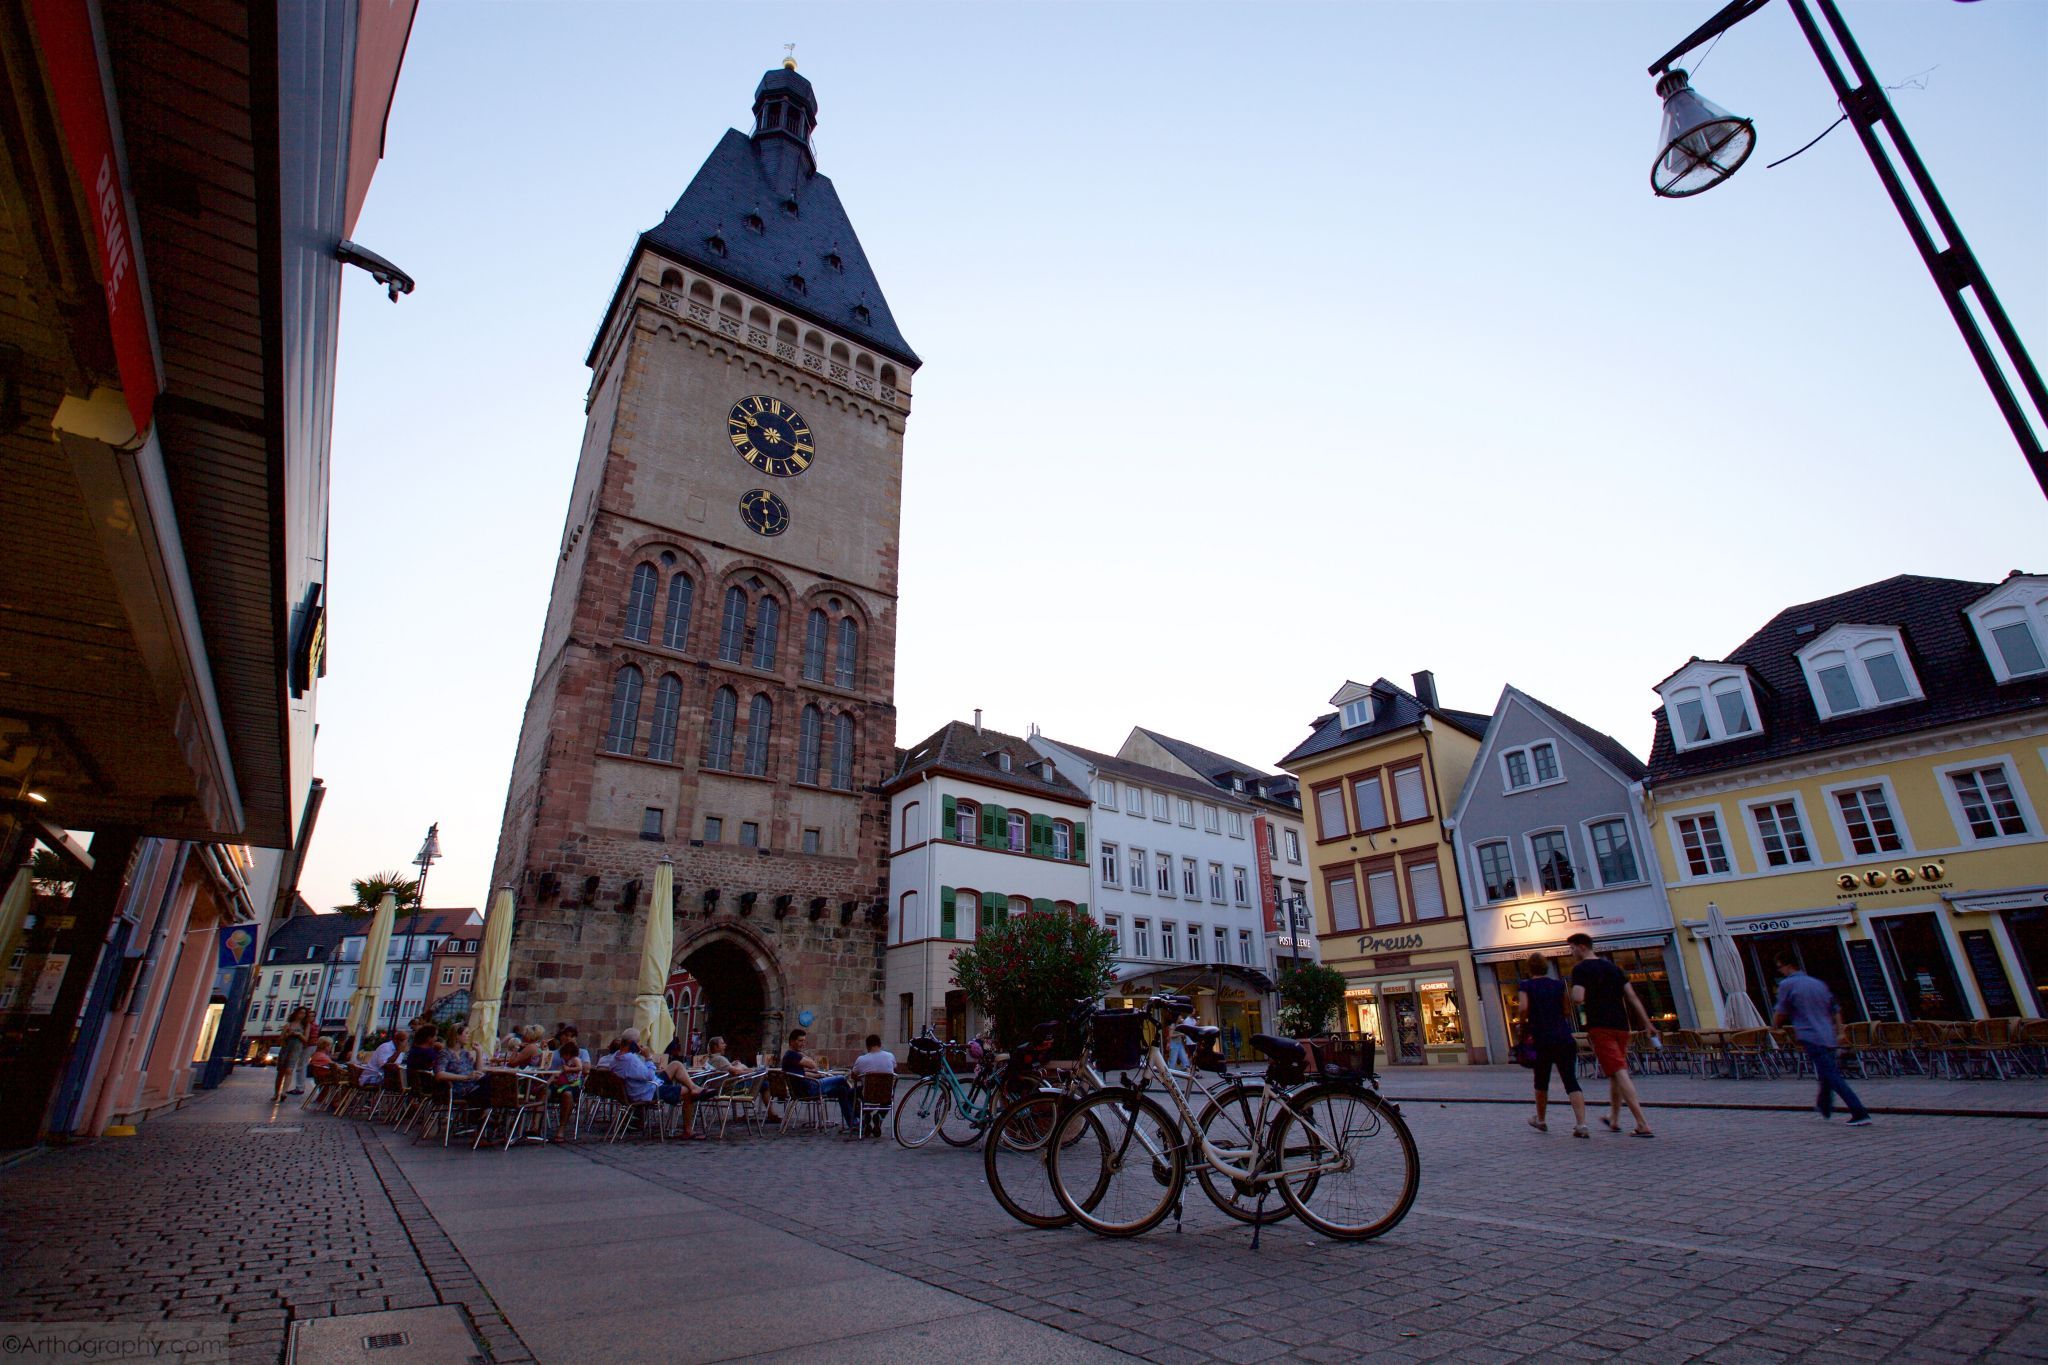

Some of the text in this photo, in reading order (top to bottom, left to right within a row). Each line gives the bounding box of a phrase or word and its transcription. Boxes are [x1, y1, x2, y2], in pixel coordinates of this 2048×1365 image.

[96, 154, 128, 295] REWE
[1261, 844, 1273, 903] POSTGALERIE
[1838, 863, 1943, 890] aran
[1504, 903, 1604, 931] ISABEL
[1749, 920, 1789, 931] aran
[1279, 935, 1311, 948] POSTLERIE
[1357, 933, 1423, 954] Preuss
[1420, 982, 1449, 991] SCHEREN
